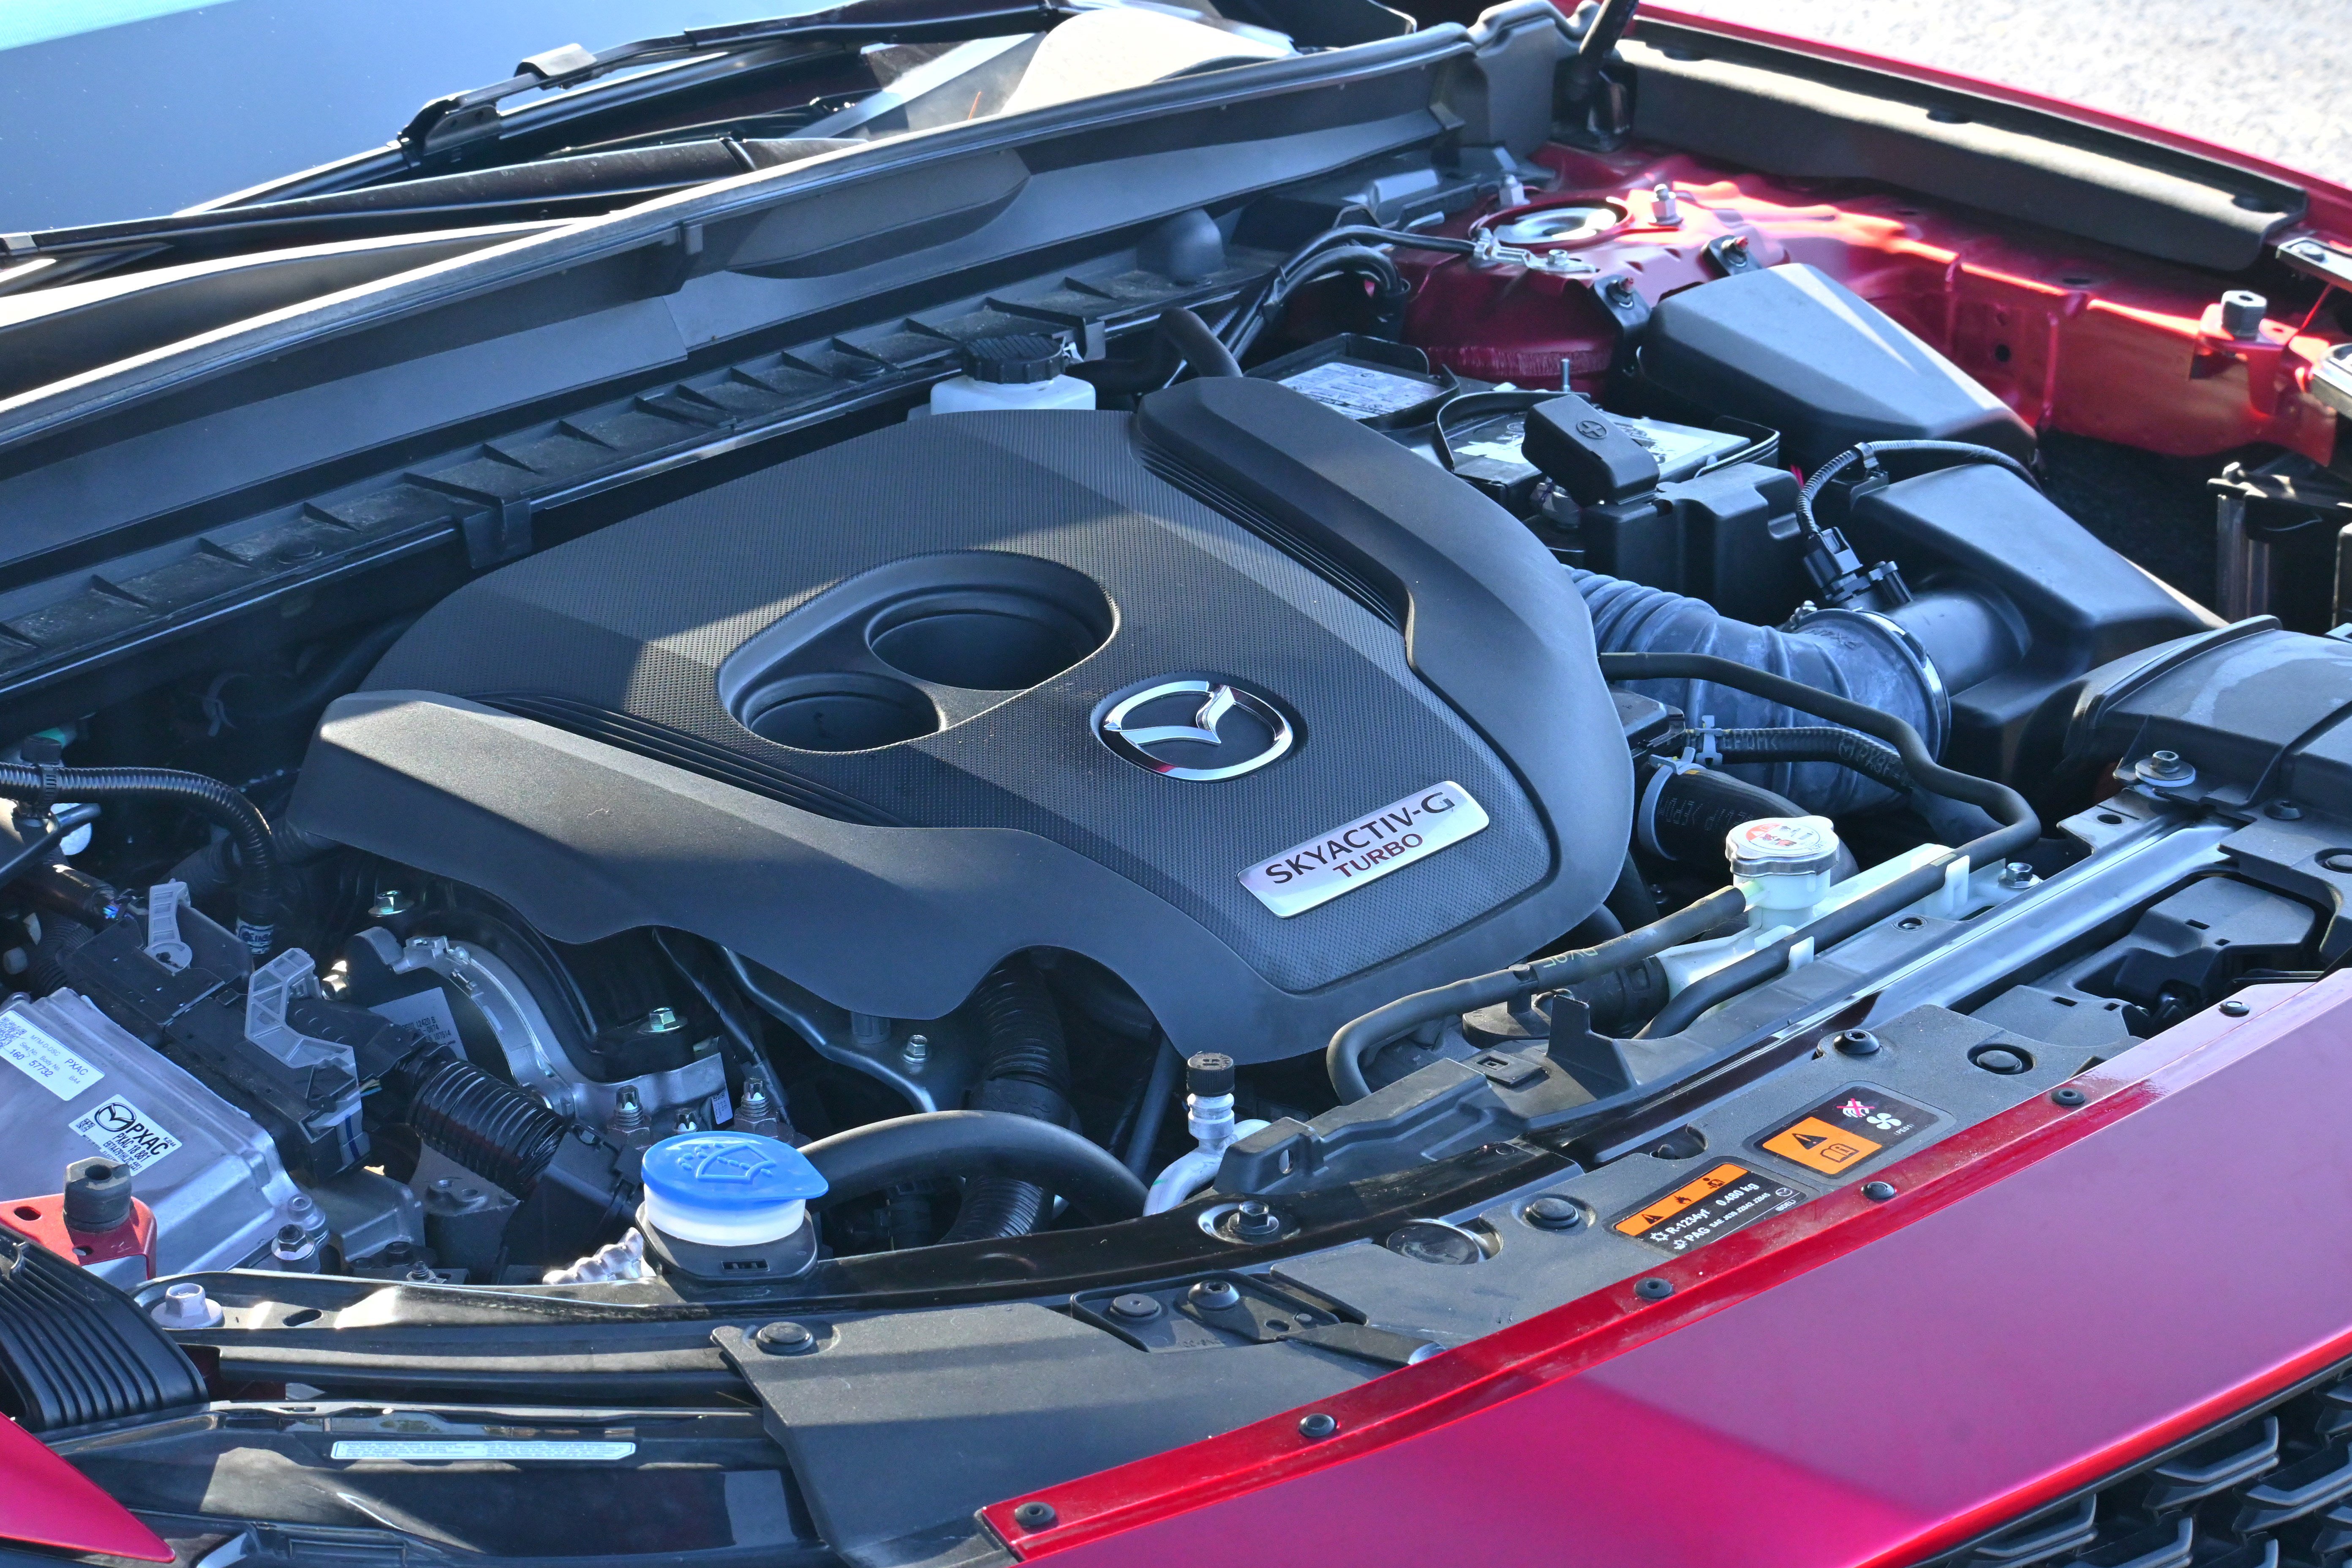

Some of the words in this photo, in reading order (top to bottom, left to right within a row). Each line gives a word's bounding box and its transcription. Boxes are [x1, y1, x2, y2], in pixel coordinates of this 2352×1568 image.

[1265, 791, 1455, 884] SKYACTIV-G
[1333, 833, 1423, 878] TURBO
[9, 1049, 25, 1060] 160
[29, 1060, 54, 1077] 57732
[20, 1042, 30, 1053] Seq
[40, 1056, 53, 1066] Body
[69, 1075, 81, 1084] BA4
[30, 1035, 61, 1056] MTM-D-DSC
[64, 1059, 88, 1075] PXAC
[112, 1133, 134, 1148] PXAC
[125, 1123, 169, 1155] PXAC
[1893, 1123, 1915, 1135] (PE01)
[128, 1145, 141, 1154] 18
[134, 1150, 152, 1162] 881
[1665, 1209, 1711, 1234] R-1234yf
[1715, 1190, 1745, 1206] 0.480
[1740, 1183, 1760, 1192] kg
[1684, 1227, 1710, 1241] PAG
[1709, 1218, 1725, 1228] SAE
[1723, 1211, 1738, 1221] J639
[1737, 1201, 1755, 1213] J2842
[1753, 1192, 1771, 1204] J2845
[1775, 1199, 1797, 1212] (BDEL)
